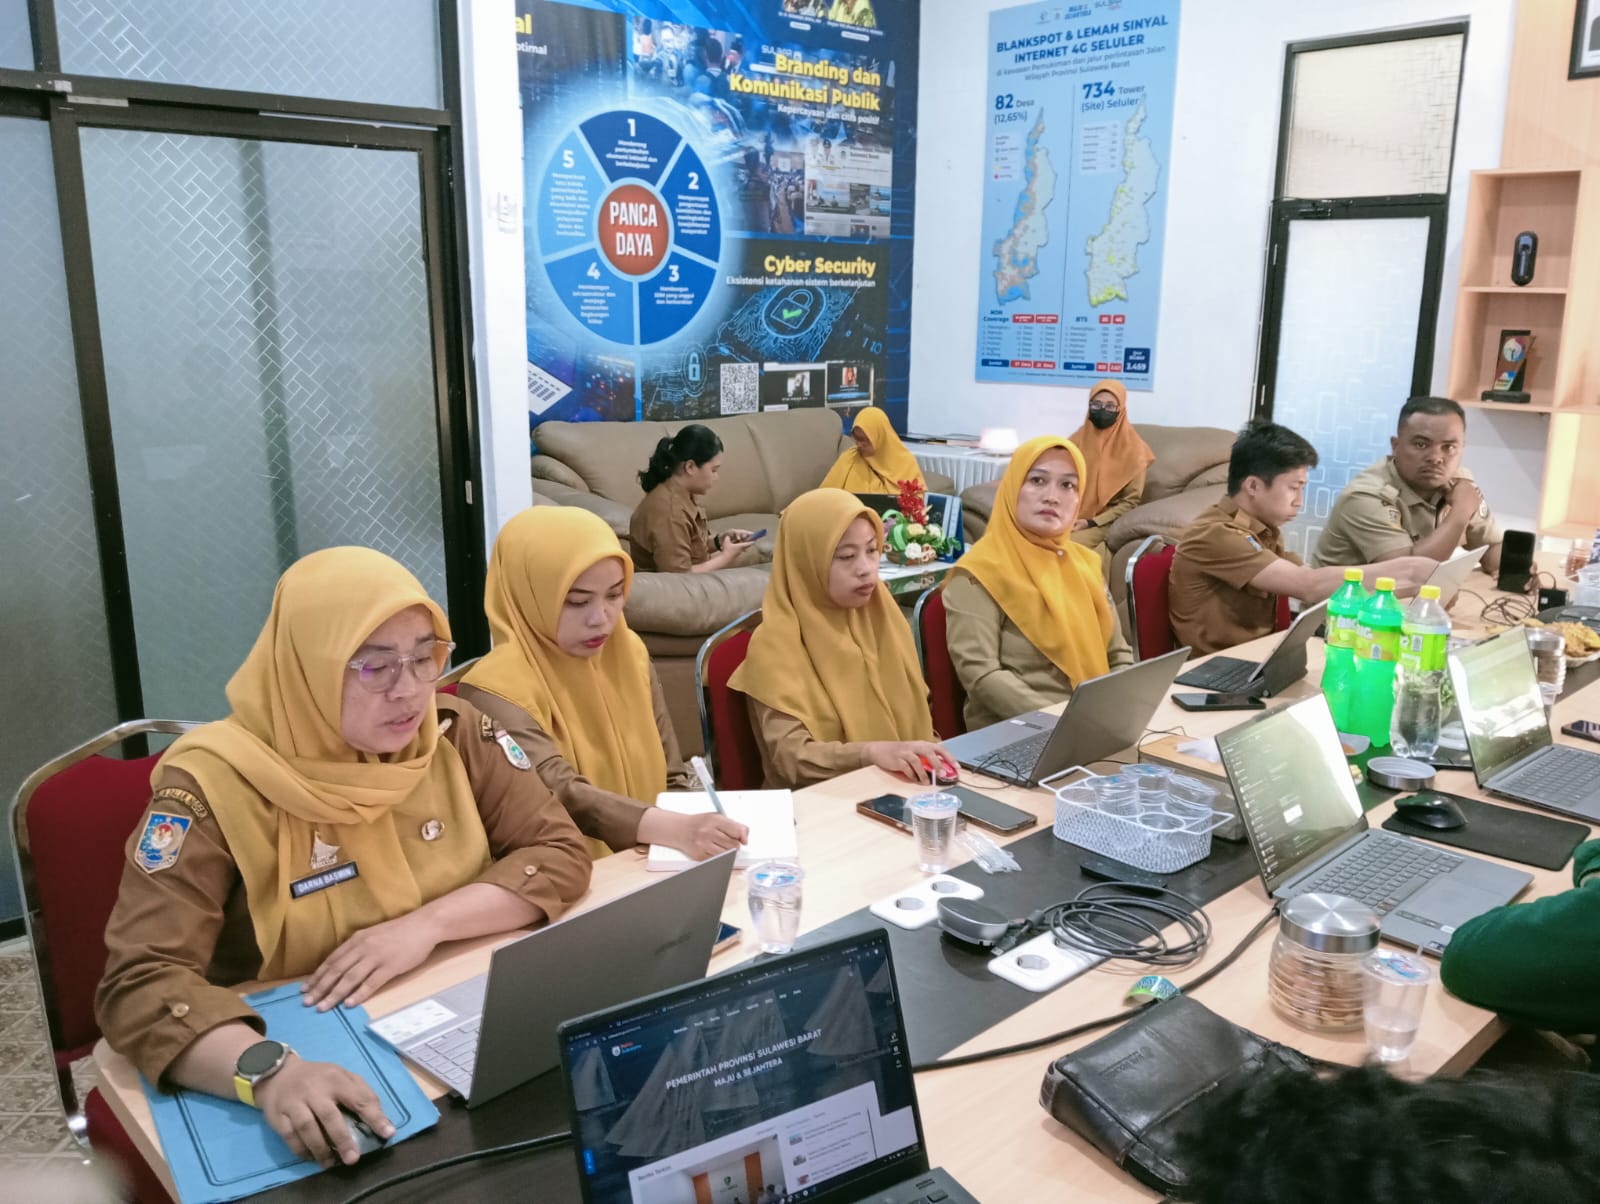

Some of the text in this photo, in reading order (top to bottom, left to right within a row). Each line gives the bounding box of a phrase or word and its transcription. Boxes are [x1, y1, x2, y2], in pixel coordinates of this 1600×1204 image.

[996, 15, 1169, 53] BLANKSPOT & LEMAH SINYAL
[1014, 34, 1145, 64] INTERNET 4G SELULER
[775, 54, 881, 87] Branding dan
[729, 73, 881, 111] Komunikasi Publik
[1082, 80, 1146, 99] 734 Tower
[994, 93, 1035, 110] 82 Desa
[1106, 96, 1140, 109] Seluler
[627, 118, 636, 137] 1
[562, 149, 575, 168] 5
[687, 172, 700, 190] 2
[609, 201, 658, 227] PANCA
[616, 231, 654, 257] DAYA
[586, 262, 601, 280] 4
[668, 264, 680, 282] 3
[764, 255, 877, 278] Cyber Security
[665, 1028, 823, 1090] PEMERINTAH PROVINSI SULAWESI BARAT
[714, 1057, 784, 1088] MAJU & SEJAHTERA
